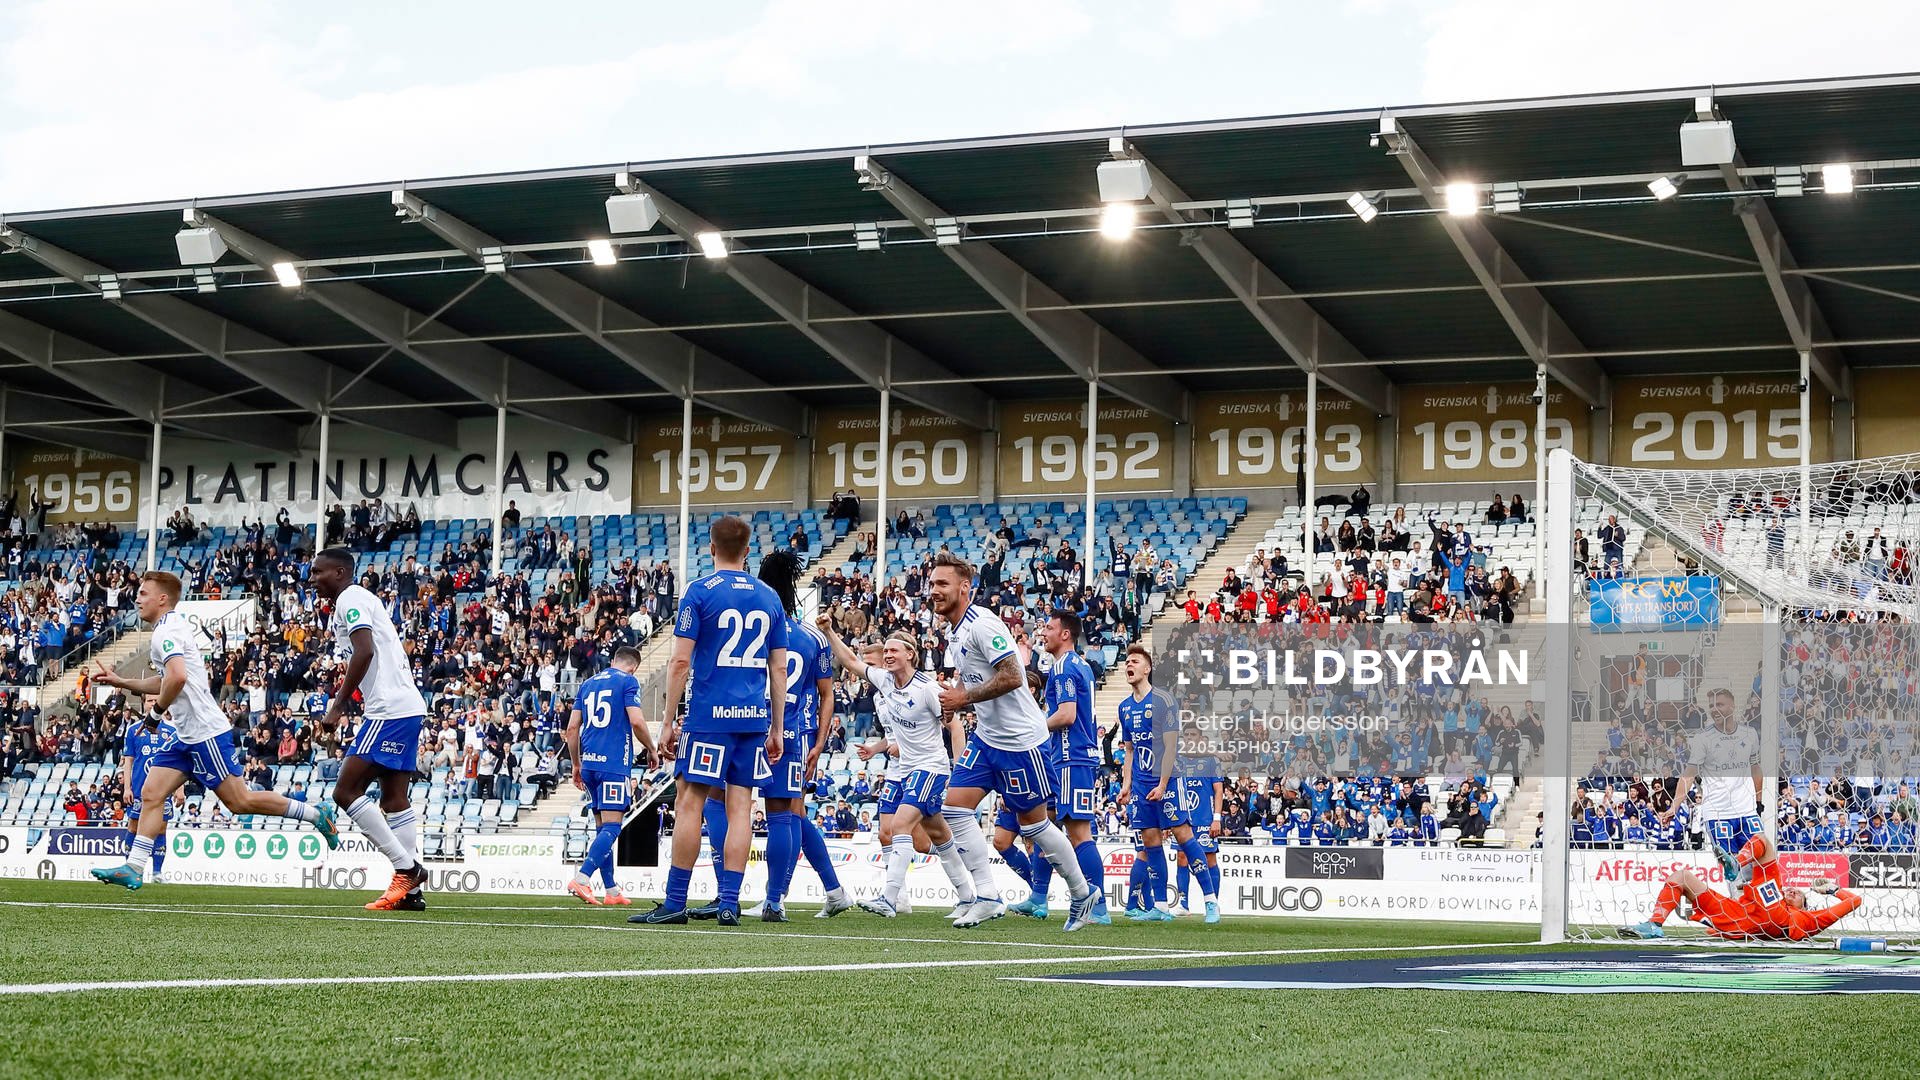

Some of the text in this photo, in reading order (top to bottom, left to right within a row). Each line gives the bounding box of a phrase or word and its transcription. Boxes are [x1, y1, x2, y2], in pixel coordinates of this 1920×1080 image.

[1423, 393, 1563, 408] SVENSKA MÄSRE
[1639, 383, 1798, 397] SVENSKA MÄSTARE
[1023, 408, 1150, 423] SVENSKA MÄSTARE
[1218, 400, 1352, 414] SVENSKA MSTARE
[658, 427, 704, 437] SVENKA
[1414, 417, 1574, 470] 1989
[1631, 408, 1812, 462] 2015
[33, 453, 69, 463] SVENSKA
[1014, 431, 1160, 483] 1962
[1209, 424, 1362, 476] 1963
[652, 445, 782, 494] 1957
[827, 439, 968, 488] 1960
[157, 449, 610, 504] PLATINUMCARS
[24, 471, 131, 514] 1956
[1621, 580, 1687, 598] RCW
[717, 608, 770, 669] 22
[584, 689, 613, 729] 15
[712, 705, 768, 720] Molinbil.se
[1061, 727, 1070, 761] tadium
[581, 753, 607, 762] inbil.se
[56, 832, 126, 855] Glimst
[337, 839, 376, 852] XPAN
[1420, 851, 1453, 861] ELITE
[1457, 852, 1502, 863] GRAND
[302, 866, 367, 889] HUGO
[490, 877, 522, 889] BOKA
[1222, 868, 1263, 878] ERIER
[1238, 885, 1323, 912] HUGO
[1338, 895, 1380, 909] BOKA
[1519, 894, 1538, 911] PÅ
